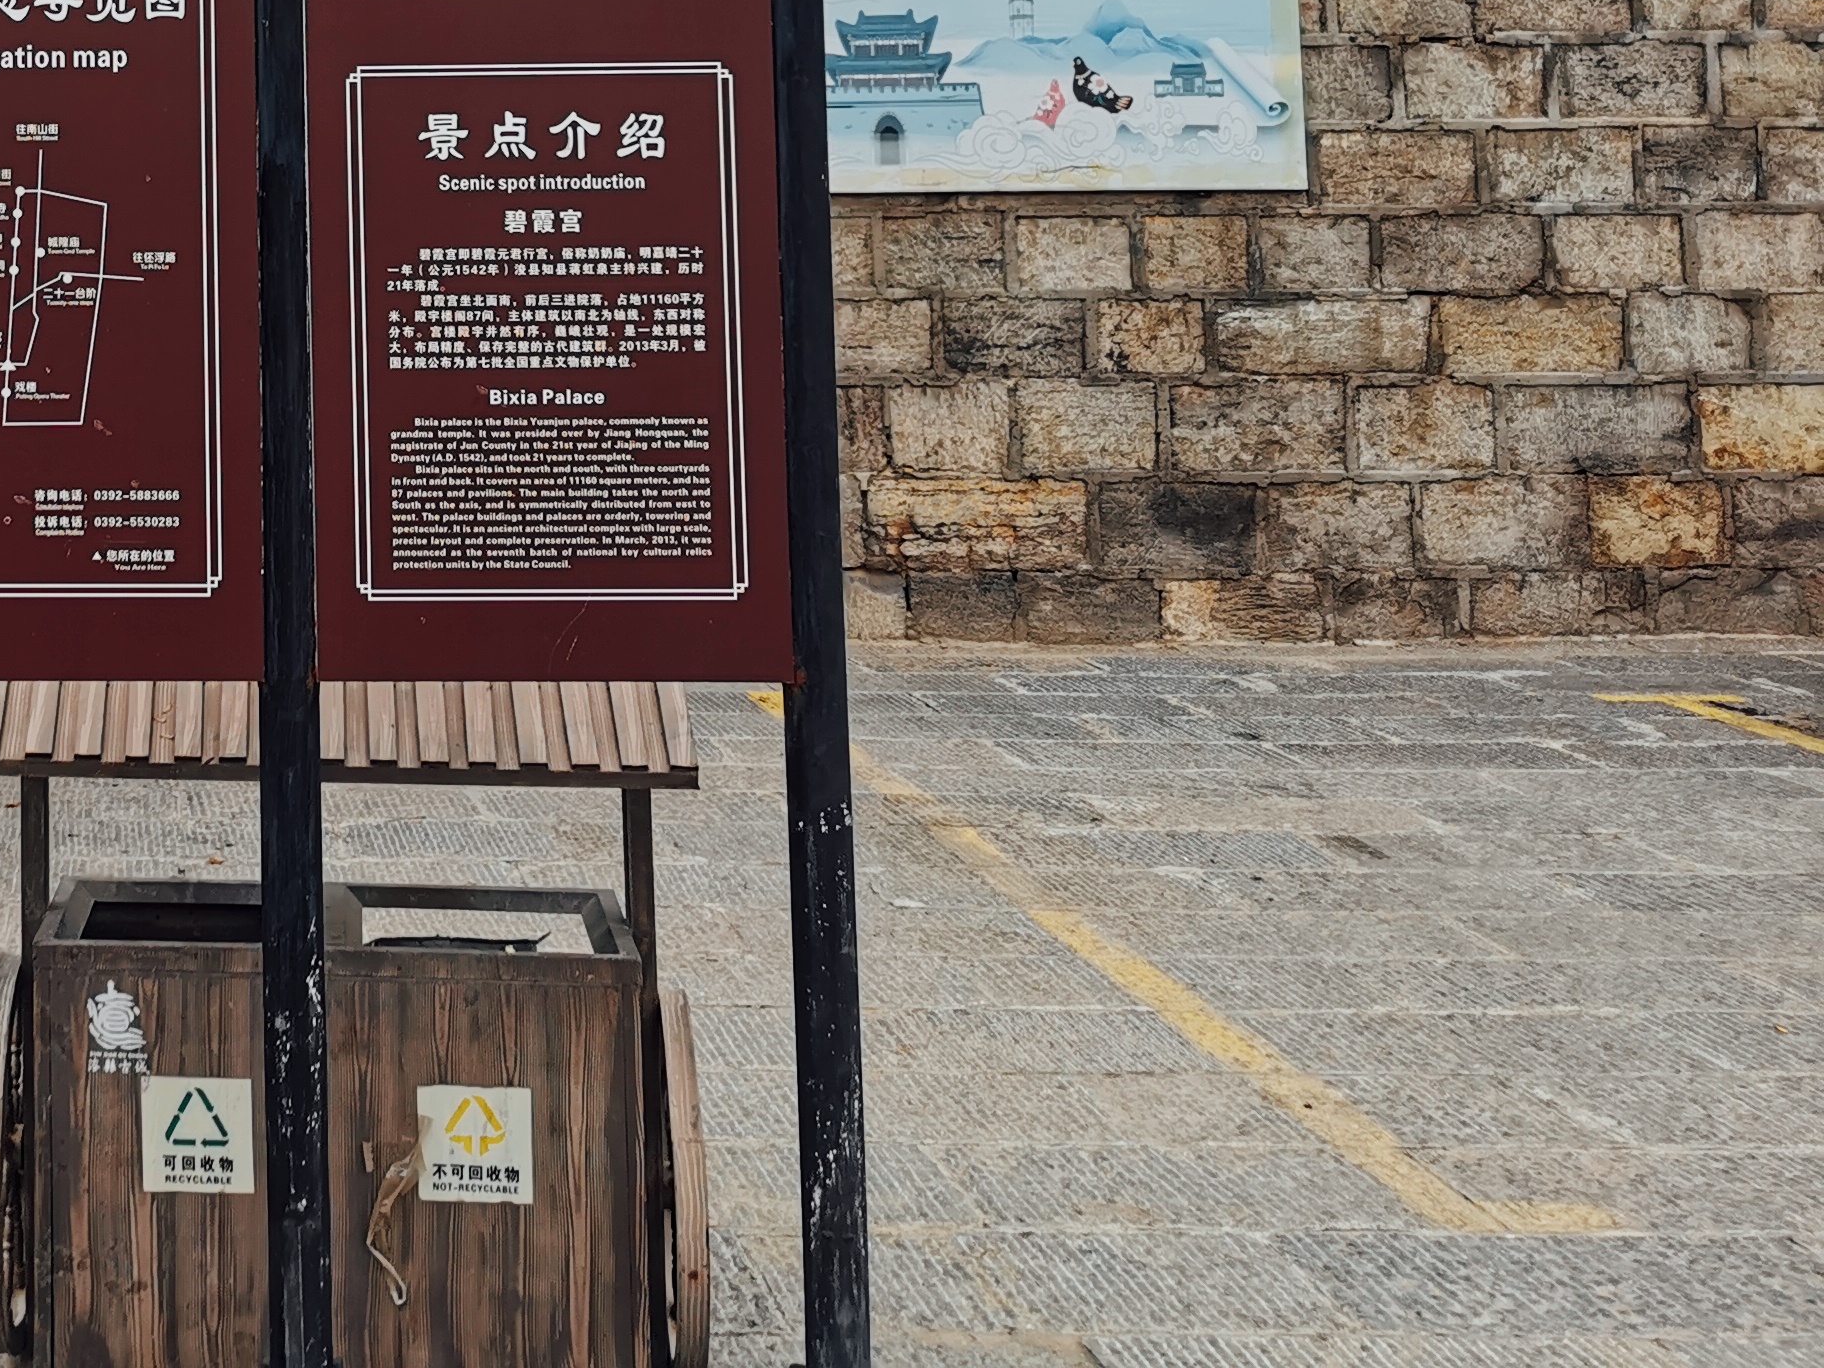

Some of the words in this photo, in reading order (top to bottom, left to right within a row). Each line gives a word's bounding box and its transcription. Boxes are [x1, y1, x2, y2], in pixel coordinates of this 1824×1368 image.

[72, 49, 128, 73] map
[15, 123, 59, 135] 往南山街
[417, 110, 666, 161] 景点介绍
[438, 173, 496, 192] Scenic
[497, 175, 537, 194] spot
[539, 172, 646, 191] introduction
[504, 208, 583, 234] 碧霞宫
[42, 286, 97, 300] 二十一台阶
[489, 388, 538, 406] Bixia
[542, 388, 605, 405] Palace
[414, 417, 439, 427] Bixia
[440, 417, 473, 429] palace
[474, 417, 484, 427] is
[484, 417, 502, 427] the
[503, 416, 529, 427] Bixia
[529, 416, 571, 428] Yuanjun
[571, 416, 608, 428] palace,
[608, 416, 661, 427] commonly
[661, 416, 696, 426] known
[696, 417, 709, 425] as
[390, 429, 434, 441] grandma
[437, 429, 475, 440] temple.
[478, 429, 487, 439] It
[490, 430, 512, 439] was
[514, 428, 558, 440] presided
[561, 429, 584, 438] over
[587, 428, 601, 440] by
[603, 428, 632, 439] Jiang
[634, 428, 689, 439] Hongquan,
[691, 428, 709, 437] the
[390, 440, 444, 452] magistrate
[446, 440, 457, 451] of
[459, 440, 479, 450] Jun
[481, 440, 517, 452] County
[519, 440, 530, 450] in
[532, 440, 550, 450] the
[551, 440, 574, 450] 21st
[576, 441, 598, 451] year
[600, 440, 612, 449] of
[613, 439, 648, 451] Jiajing
[650, 439, 662, 449] of
[664, 439, 681, 449] the
[683, 439, 710, 451] Ming
[390, 452, 431, 464] Dynasty
[431, 452, 457, 463] (A.D.
[458, 452, 488, 463] 1542),
[488, 452, 508, 462] and
[508, 452, 532, 463] took
[532, 452, 544, 462] 21
[545, 454, 573, 464] years
[573, 453, 585, 462] to
[585, 451, 635, 463] complete.
[415, 464, 440, 475] Bixia
[441, 464, 474, 476] palace
[474, 464, 493, 474] sits
[494, 464, 505, 474] in
[505, 464, 523, 474] the
[523, 464, 551, 474] north
[552, 464, 572, 474] and
[572, 464, 604, 475] south,
[604, 463, 628, 473] with
[629, 463, 656, 473] three
[656, 463, 710, 475] courtyards
[93, 489, 180, 501] 0392-5883666
[391, 488, 404, 499] 87
[406, 488, 444, 500] palaces
[446, 488, 466, 498] and
[467, 488, 516, 499] pavilions.
[518, 487, 538, 498] The
[540, 487, 566, 497] main
[567, 487, 609, 499] building
[611, 487, 639, 497] takes
[641, 487, 659, 497] the
[661, 487, 689, 497] north
[691, 487, 711, 497] and
[93, 516, 180, 528] 0392-5530283
[391, 513, 419, 522] west.
[421, 511, 441, 522] The
[442, 511, 475, 523] palace
[476, 511, 523, 523] buildings
[525, 511, 544, 521] and
[545, 511, 584, 523] palaces
[585, 513, 602, 521] are
[604, 511, 643, 523] orderly,
[645, 511, 691, 522] towering
[692, 511, 712, 521] and
[392, 523, 451, 535] spectacular.
[452, 523, 461, 534] It
[462, 524, 472, 534] is
[472, 525, 486, 534] an
[486, 524, 524, 533] ancient
[524, 523, 588, 533] architectural
[588, 523, 631, 535] complex
[631, 523, 655, 533] with
[656, 523, 682, 534] large
[683, 523, 712, 533] scale,
[392, 536, 428, 547] precise
[430, 535, 462, 547] layout
[464, 535, 484, 545] and
[485, 535, 532, 547] complete
[534, 535, 599, 547] preservation.
[601, 535, 613, 545] In
[614, 535, 649, 546] March,
[651, 535, 679, 545] 2013,
[680, 535, 689, 545] it
[691, 536, 712, 545] was
[106, 548, 175, 563] 您所在的位置
[392, 547, 447, 557] announced
[450, 549, 462, 557] as
[465, 547, 483, 557] the
[486, 547, 526, 557] seventh
[529, 547, 558, 557] batch
[561, 547, 573, 557] of
[576, 547, 618, 557] national
[621, 547, 639, 559] key
[642, 547, 682, 557] cultural
[685, 547, 713, 557] relics
[163, 1154, 234, 1174] 可回收物
[165, 1175, 232, 1185] RECYCLABLE
[432, 1164, 520, 1183] 不可回收物
[433, 1183, 520, 1194] NOT-RECYCLABLE
